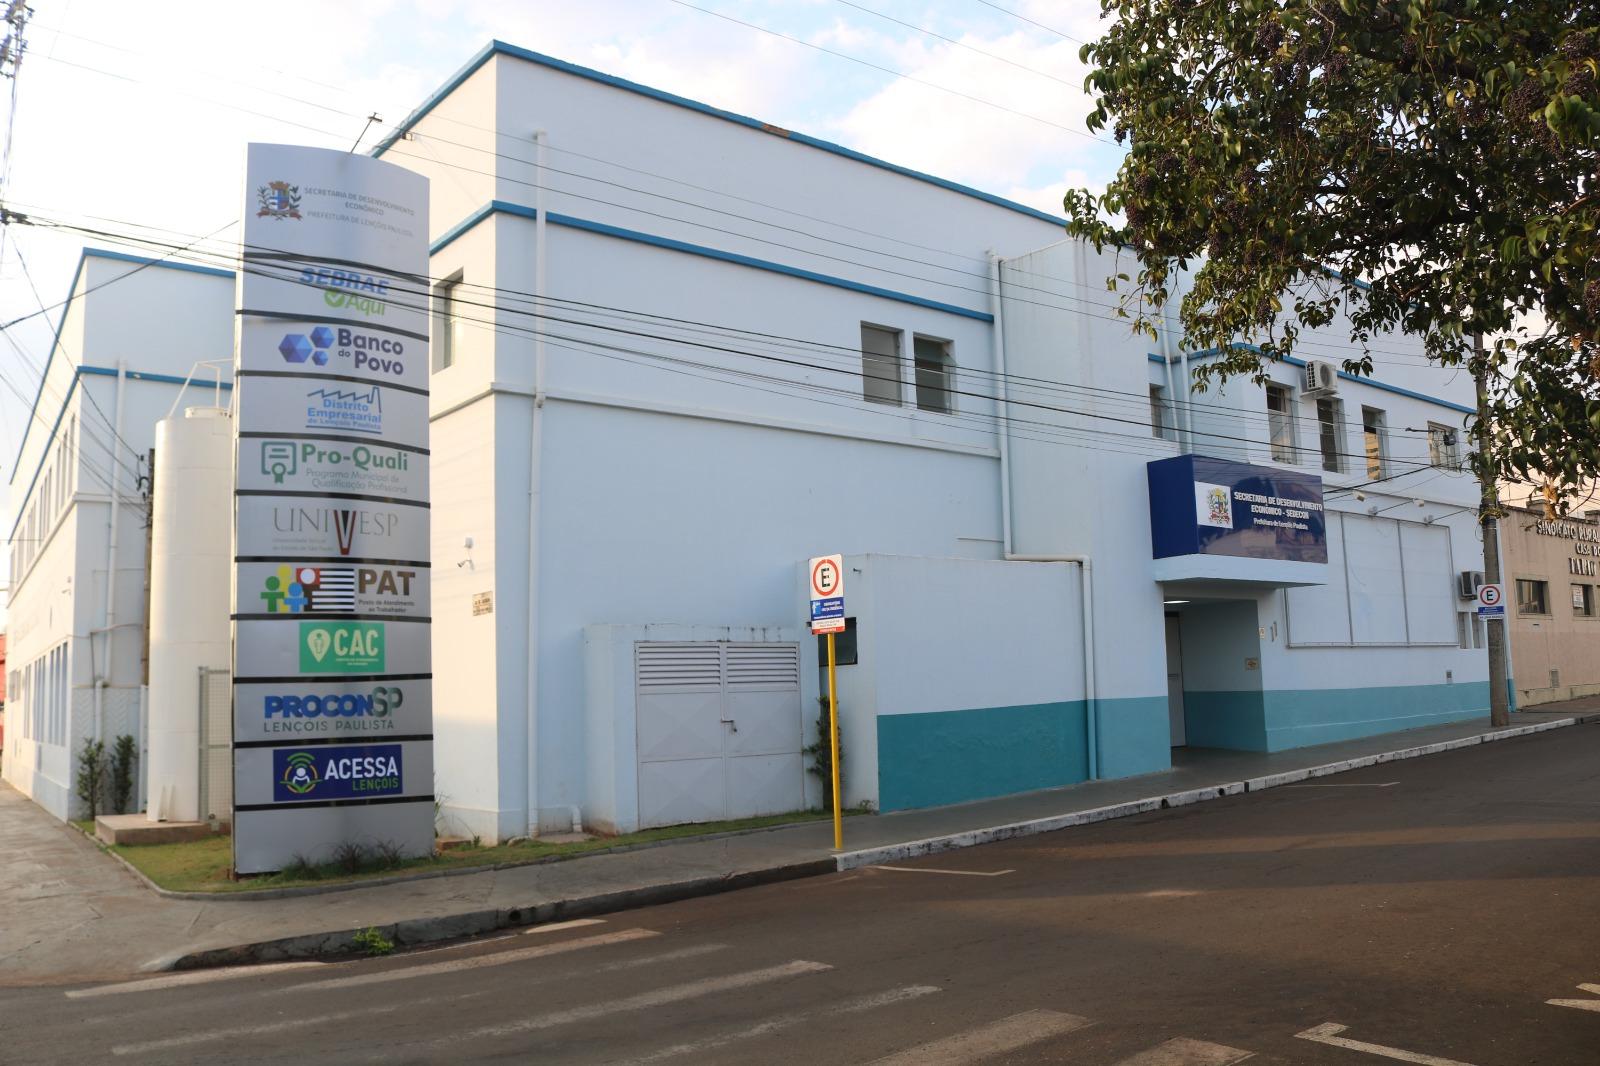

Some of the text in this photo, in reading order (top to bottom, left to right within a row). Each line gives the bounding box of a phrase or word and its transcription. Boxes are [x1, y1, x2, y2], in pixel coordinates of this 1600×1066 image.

[304, 187, 415, 216] SECRETARIA DE DESENVOLVIMENTO
[307, 211, 350, 223] PREFEITURA
[351, 216, 360, 225] DE
[300, 267, 389, 295] SEBRAE
[346, 293, 386, 316] Aqui
[338, 327, 404, 355] Banco
[338, 350, 404, 375] do Povo
[323, 398, 369, 412] Distrito
[307, 407, 382, 424] Empresarial
[301, 443, 408, 471] Pro-Quali
[306, 467, 349, 481] Programa
[391, 473, 399, 483] de
[1234, 492, 1323, 511] SECRETARIA DE DESENVOLVIMENTO
[1286, 510, 1310, 520] SEDECON
[274, 507, 399, 556] UNIVESP
[1537, 519, 1577, 539] SINDICATO
[1576, 542, 1591, 555] CASA
[358, 568, 416, 596] PAT
[821, 568, 831, 588] E
[1486, 590, 1494, 601] E
[334, 629, 379, 656] CAC
[336, 719, 394, 731] PAULISTA
[324, 756, 398, 780] ACESSA
